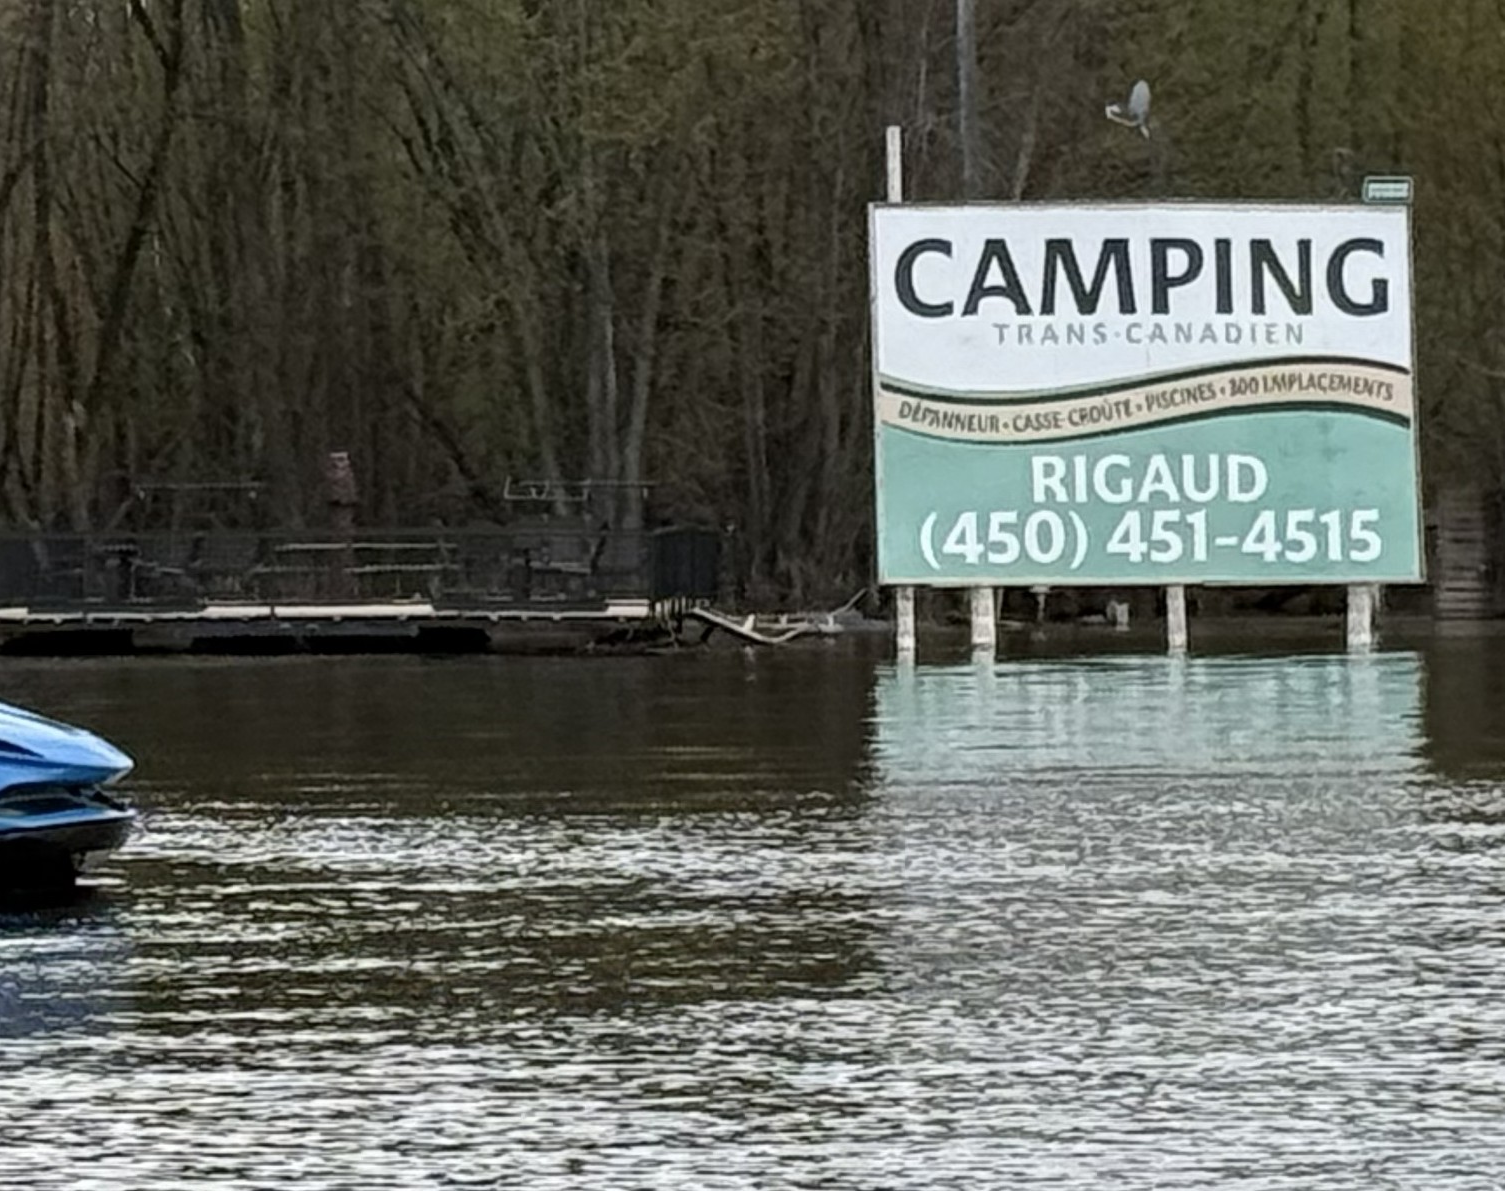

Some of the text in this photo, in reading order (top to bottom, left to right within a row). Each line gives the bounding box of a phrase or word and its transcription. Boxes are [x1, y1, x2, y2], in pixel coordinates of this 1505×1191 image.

[894, 237, 1390, 319] CAMPING
[898, 400, 1000, 434] DÉPANNEUR
[1145, 382, 1218, 412] PISCINES
[1262, 371, 1393, 401] EMPLACEMENTS
[1031, 453, 1269, 503] RIGAUD
[920, 508, 1383, 570] (450) 451-4515
